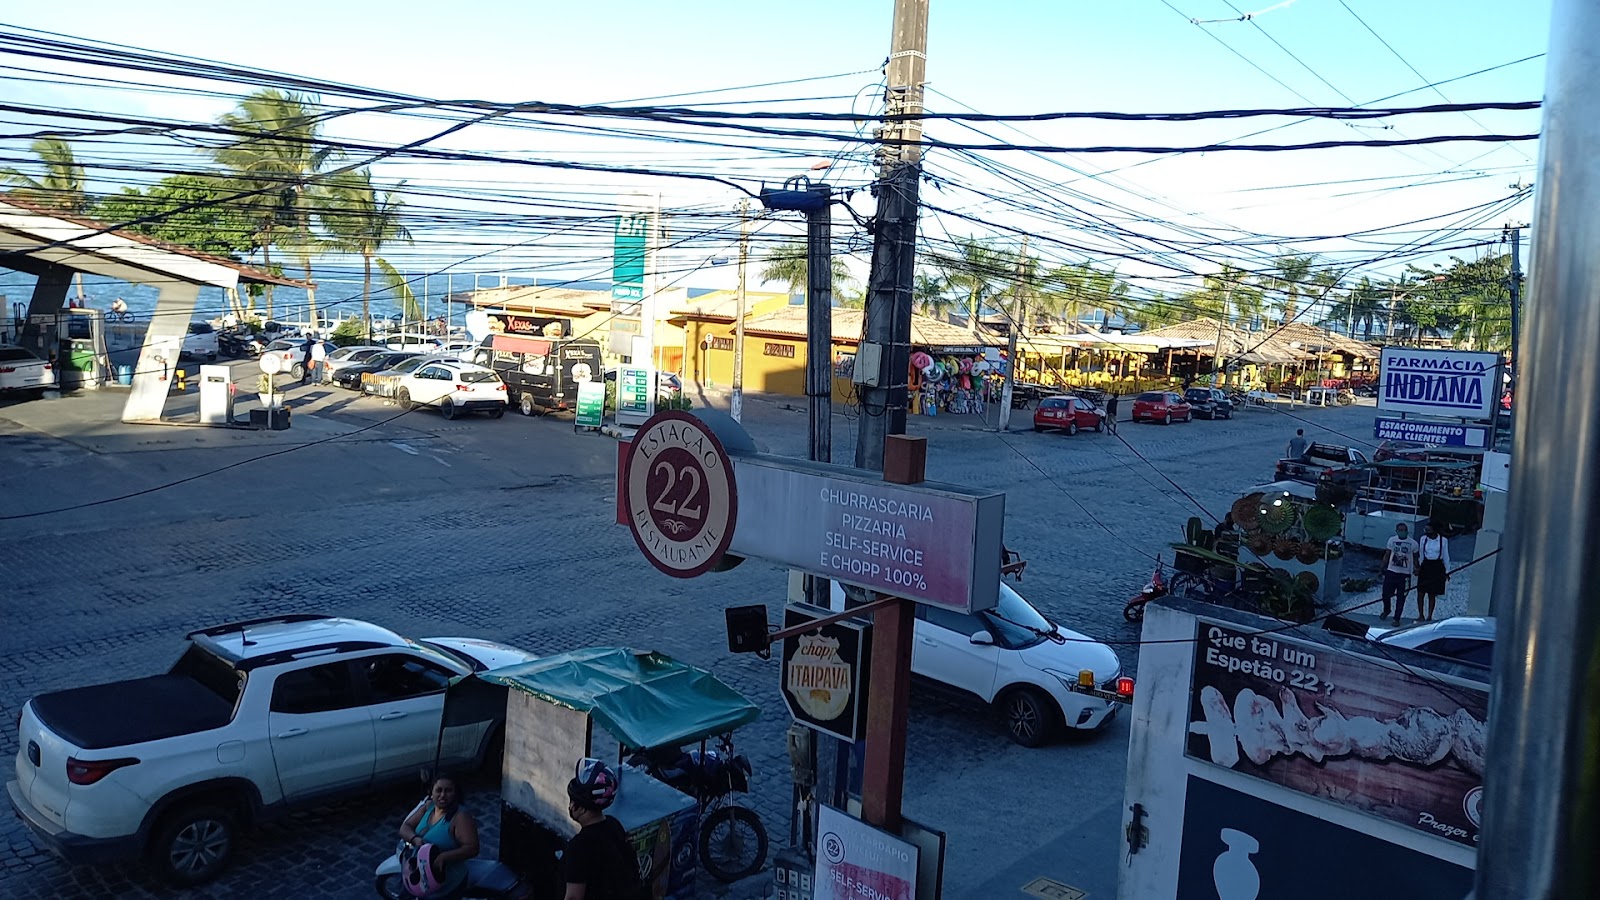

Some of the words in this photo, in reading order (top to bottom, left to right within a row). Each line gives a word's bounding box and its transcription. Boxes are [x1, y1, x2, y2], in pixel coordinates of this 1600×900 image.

[1388, 357, 1485, 371] FARMÁCIA
[1386, 373, 1482, 404] INDIANA
[1379, 430, 1402, 440] PARA
[1404, 432, 1447, 444] CLIENTES
[1380, 421, 1463, 436] ESTACIONAMENTO
[640, 424, 717, 468] ESTAÇÃO
[653, 461, 701, 520] 22
[820, 488, 933, 522] CHURRASCARIA
[636, 509, 719, 563] RESTAURANTE
[842, 513, 906, 540] PIZZARIA
[825, 531, 923, 566] SELF-SERVICE
[820, 552, 828, 567] E
[831, 555, 880, 578] CHOPP
[884, 567, 927, 590] 100%
[801, 641, 837, 662] chopp
[1208, 627, 1246, 650] Que
[1251, 637, 1278, 658] tal
[1283, 648, 1316, 668] um
[791, 665, 848, 689] ITAIPAVA
[1206, 647, 1285, 683] Espetão
[1418, 812, 1468, 838] Prazer
[828, 840, 839, 854] 22
